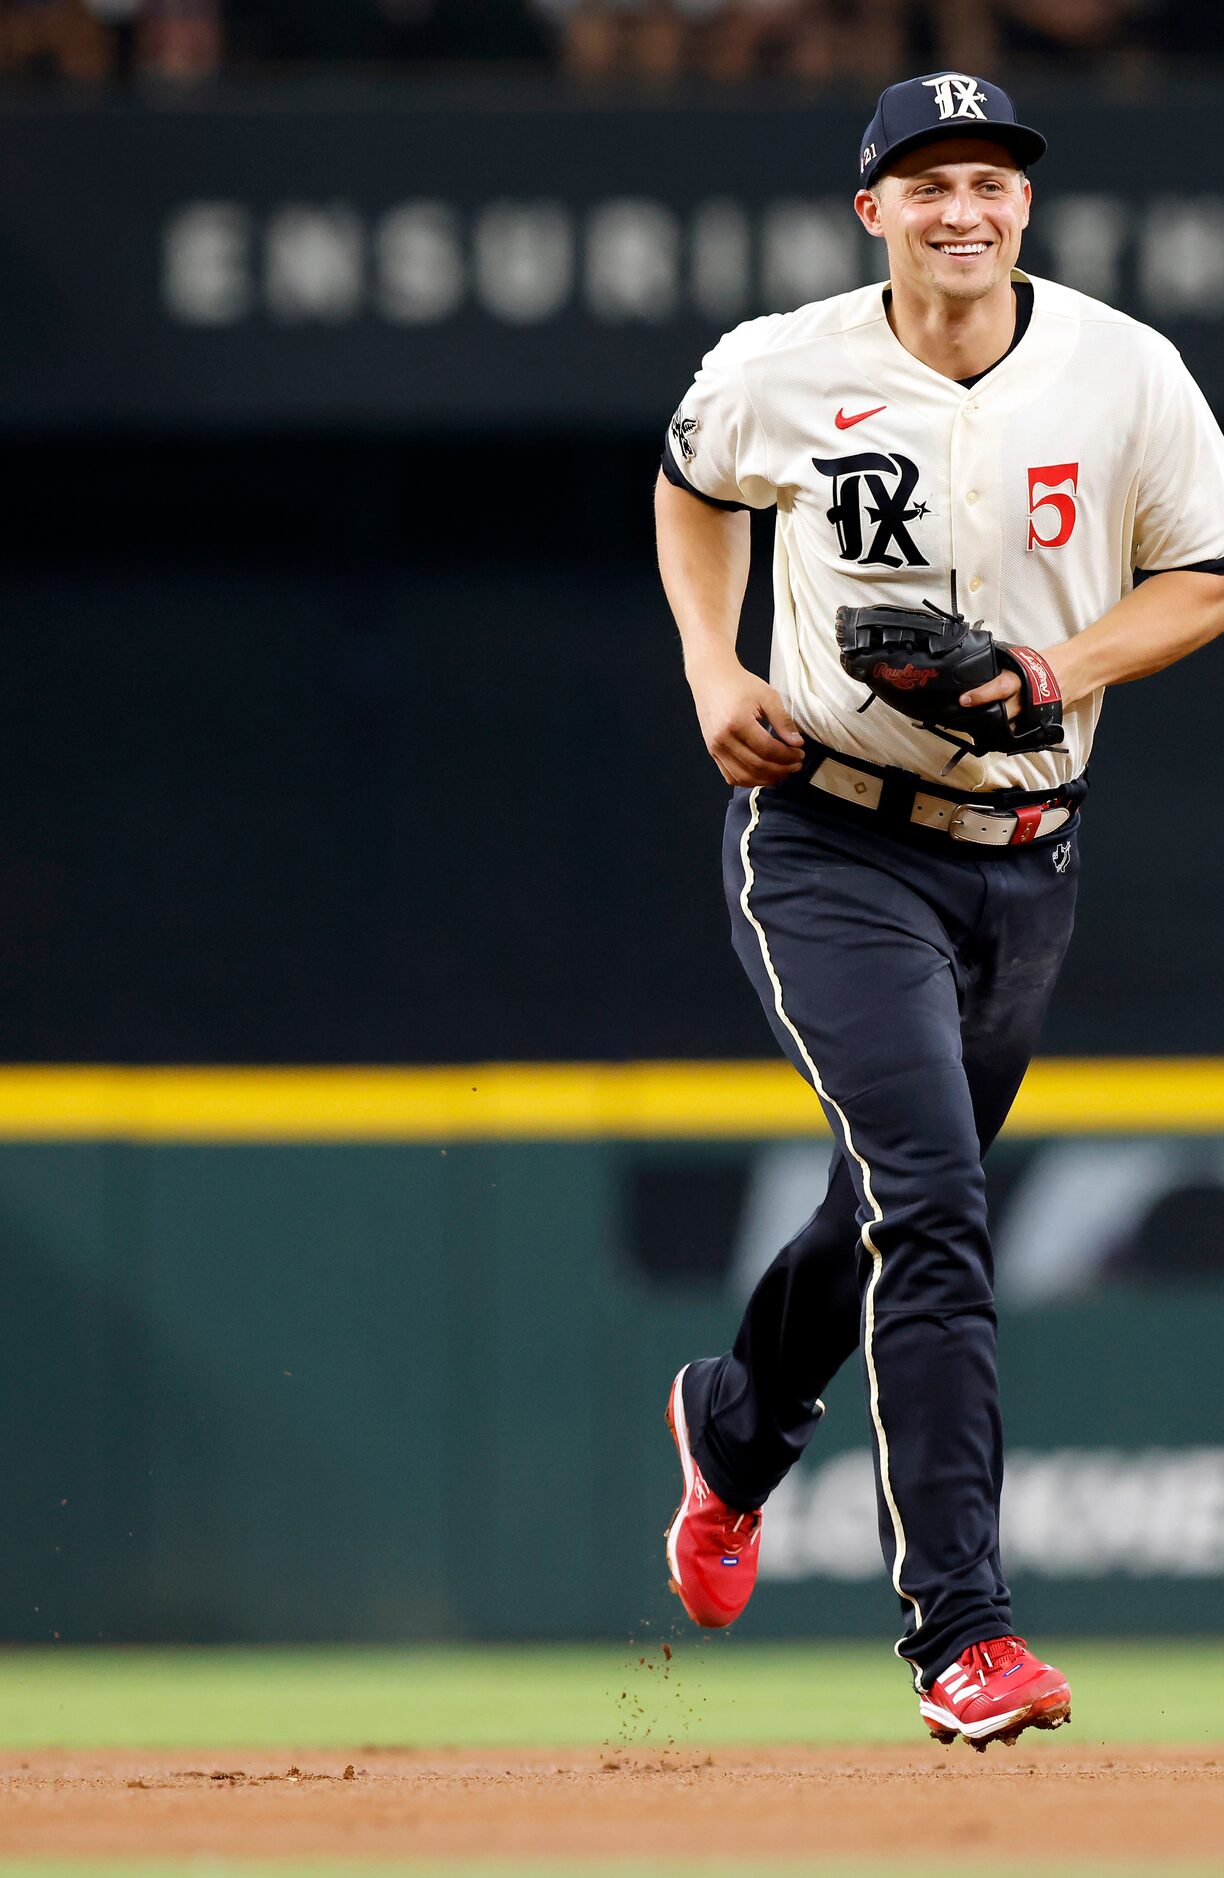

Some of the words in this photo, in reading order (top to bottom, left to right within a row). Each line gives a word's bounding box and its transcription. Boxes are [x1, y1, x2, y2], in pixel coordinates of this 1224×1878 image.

[163, 192, 878, 318] ENSURIN
[1027, 462, 1079, 551] 5
[873, 661, 939, 689] Rawlings
